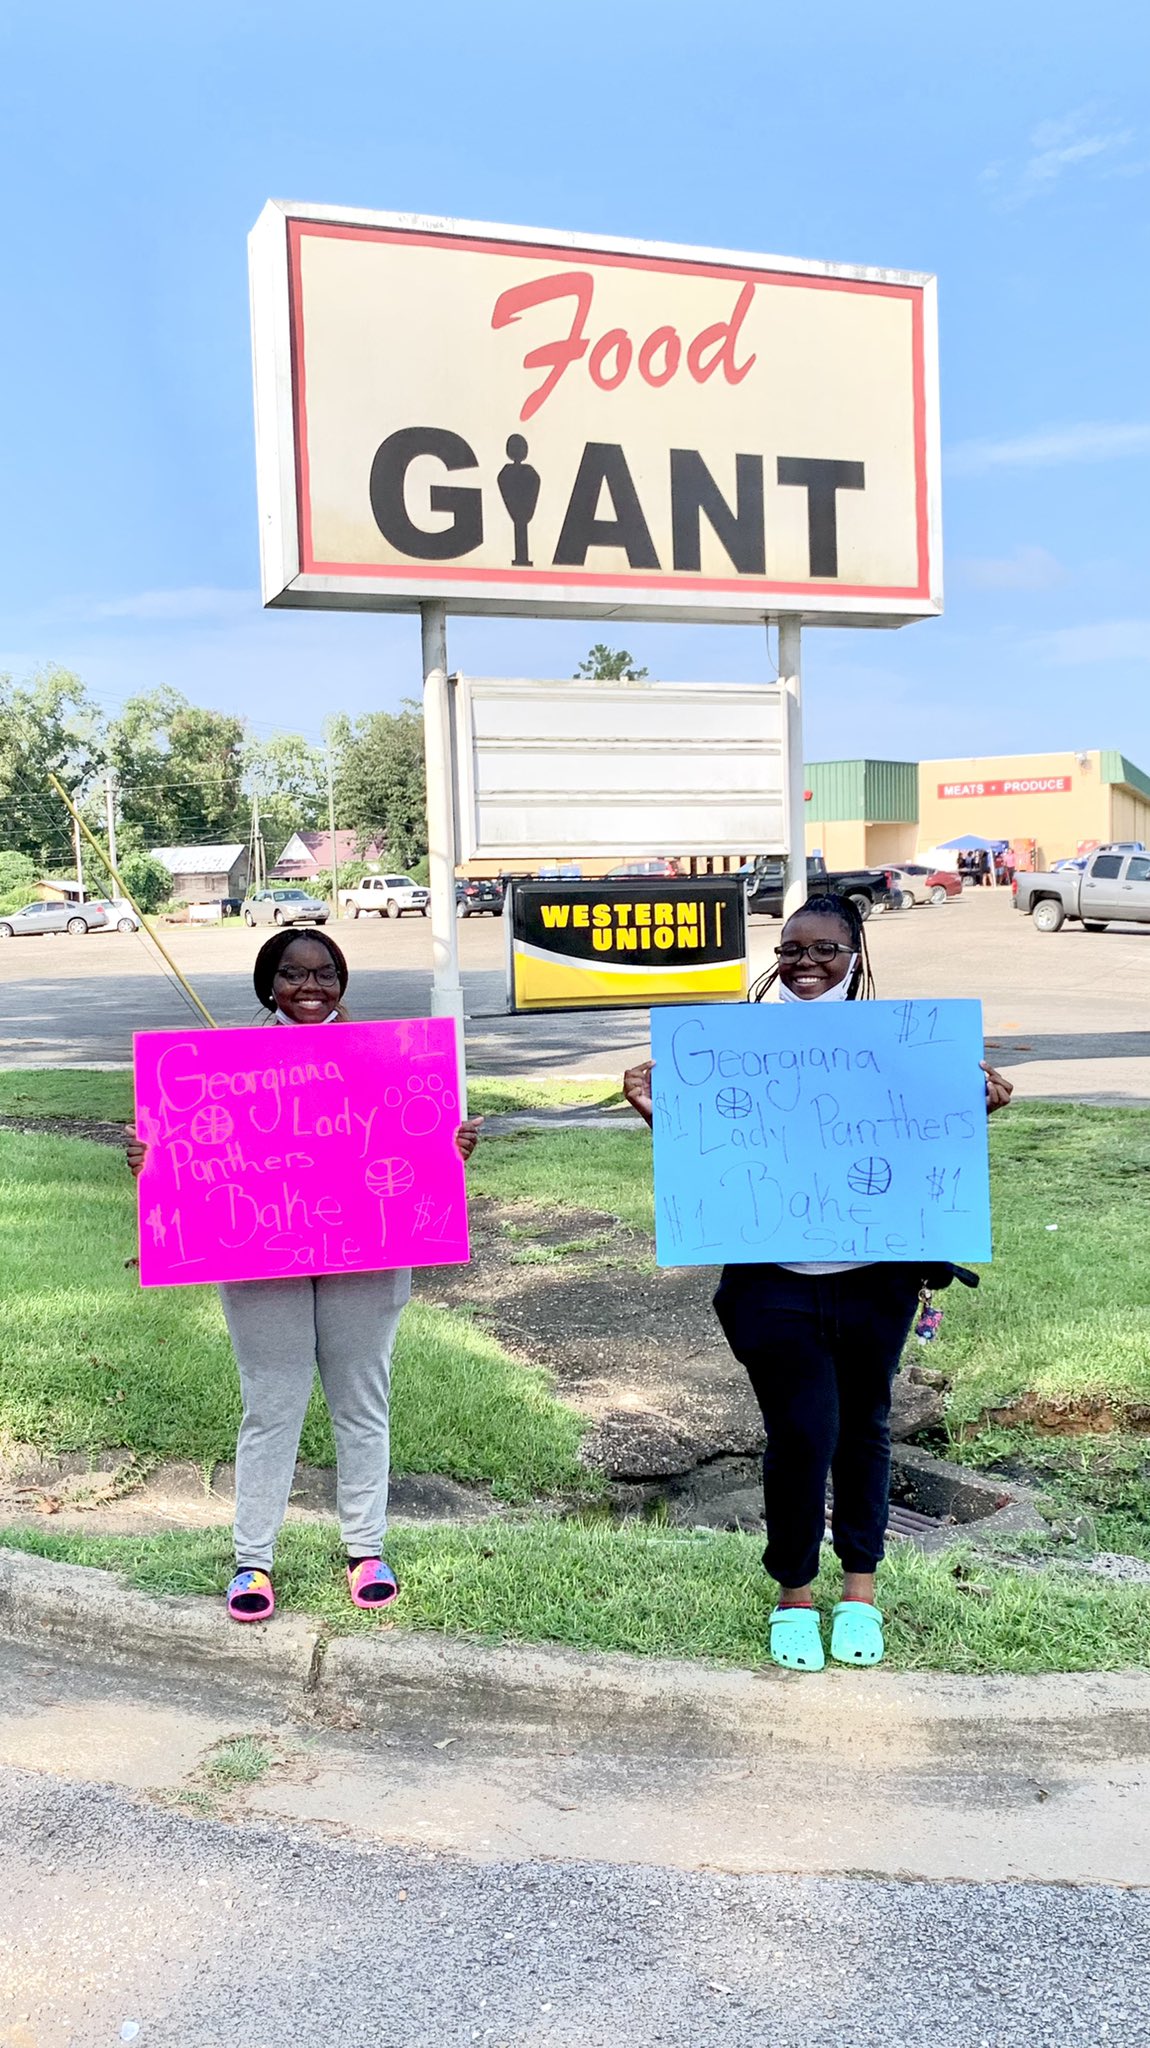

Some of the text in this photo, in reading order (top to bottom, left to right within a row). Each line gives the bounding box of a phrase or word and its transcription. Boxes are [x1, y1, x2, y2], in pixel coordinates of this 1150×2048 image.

[492, 271, 757, 422] Food
[369, 426, 865, 579] GIANT
[943, 778, 1065, 796] MEATS PRODUCE
[540, 902, 698, 928] WESTERN
[592, 926, 699, 951] UNION
[893, 1001, 957, 1048] $1
[157, 1043, 345, 1133] Georgiana
[671, 1019, 881, 1112] Georgiana
[293, 1096, 378, 1159] Lady
[655, 1091, 689, 1141] $1
[699, 1089, 976, 1164] Lady Panthers
[165, 1138, 315, 1191] Panthers
[926, 1166, 971, 1213] $1
[205, 1182, 343, 1249] Bake
[411, 1194, 463, 1244] $1
[720, 1161, 882, 1244] Bake
[146, 1204, 206, 1268] $1
